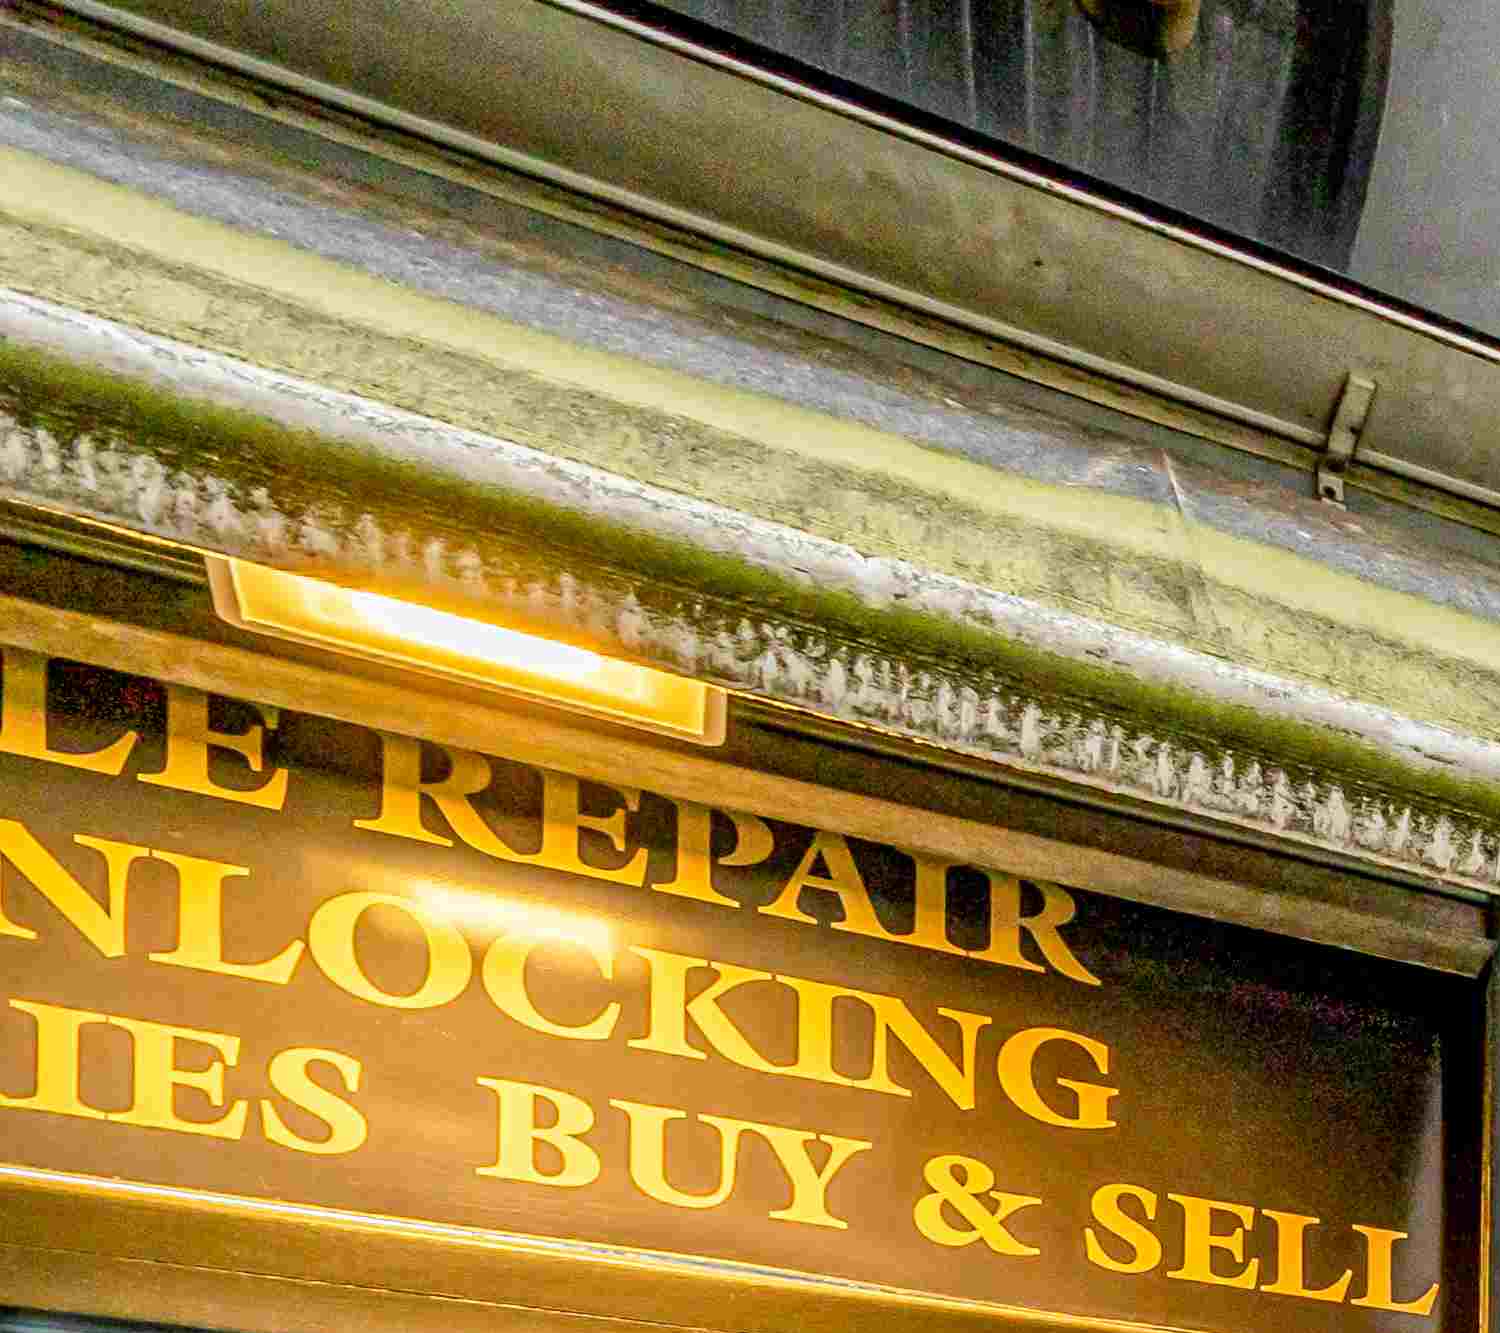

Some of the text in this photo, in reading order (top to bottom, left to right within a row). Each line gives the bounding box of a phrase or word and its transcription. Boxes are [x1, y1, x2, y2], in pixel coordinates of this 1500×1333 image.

[353, 733, 1101, 986] REPAIR
[475, 1075, 873, 1230] BUY
[913, 1155, 1040, 1257] &
[1085, 1183, 1441, 1317] SELL
